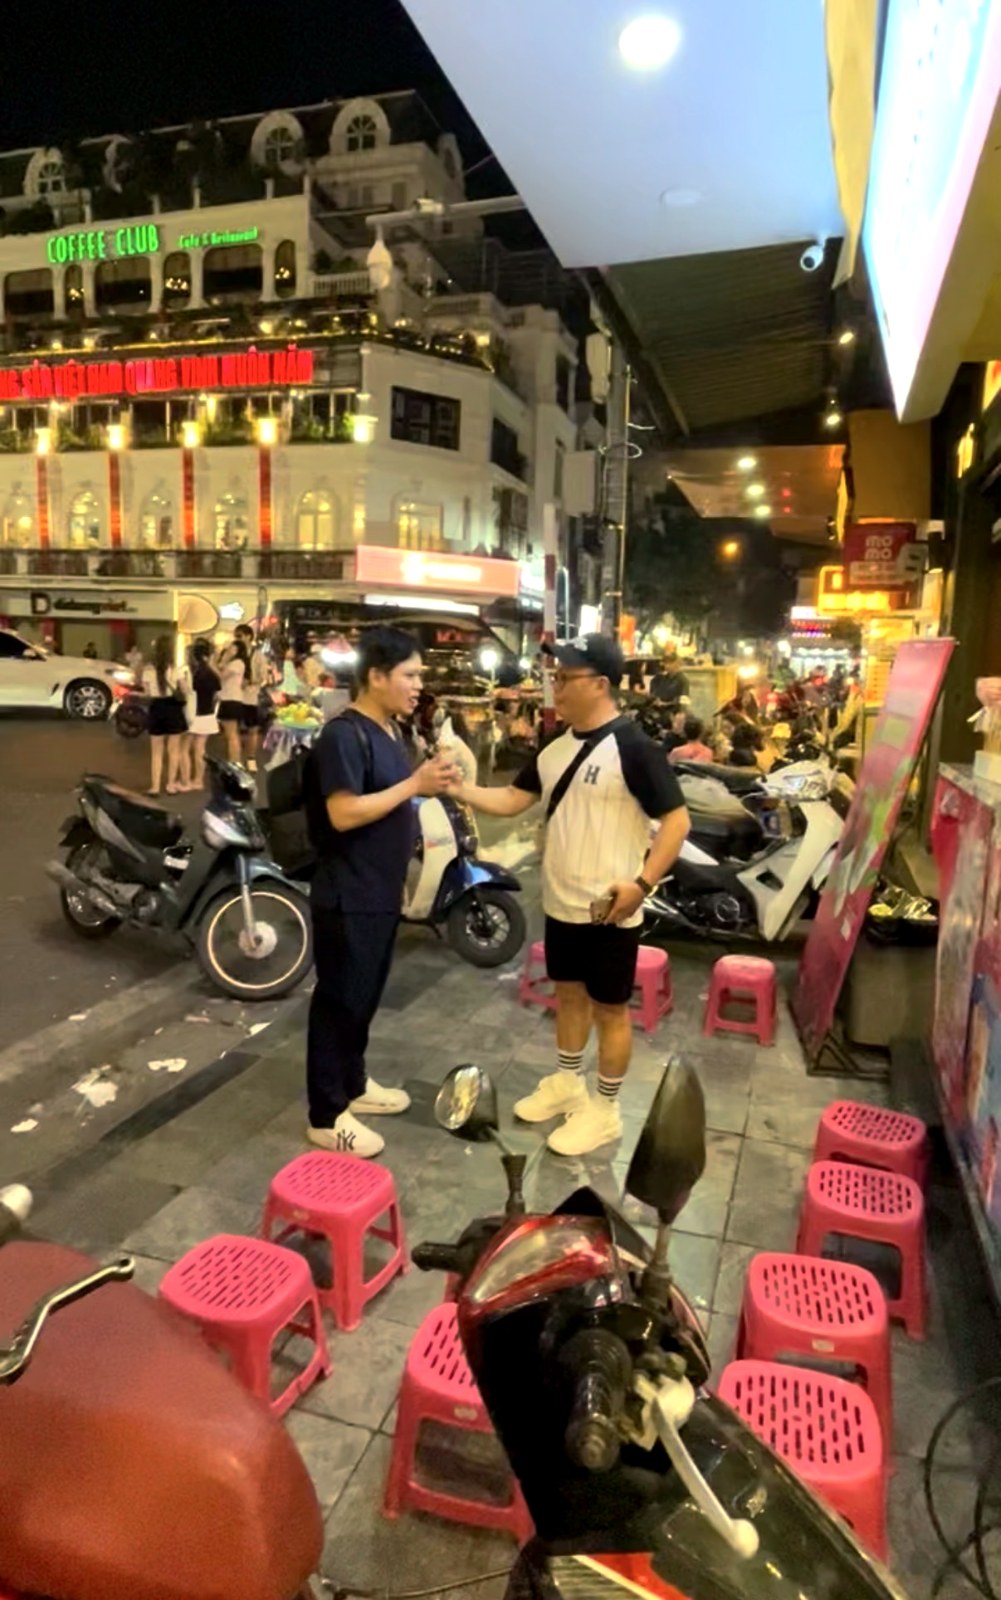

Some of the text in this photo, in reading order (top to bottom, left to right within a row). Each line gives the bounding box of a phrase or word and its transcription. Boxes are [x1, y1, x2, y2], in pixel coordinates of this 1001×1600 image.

[48, 224, 159, 263] COFFEE CLUB
[583, 764, 600, 785] H
